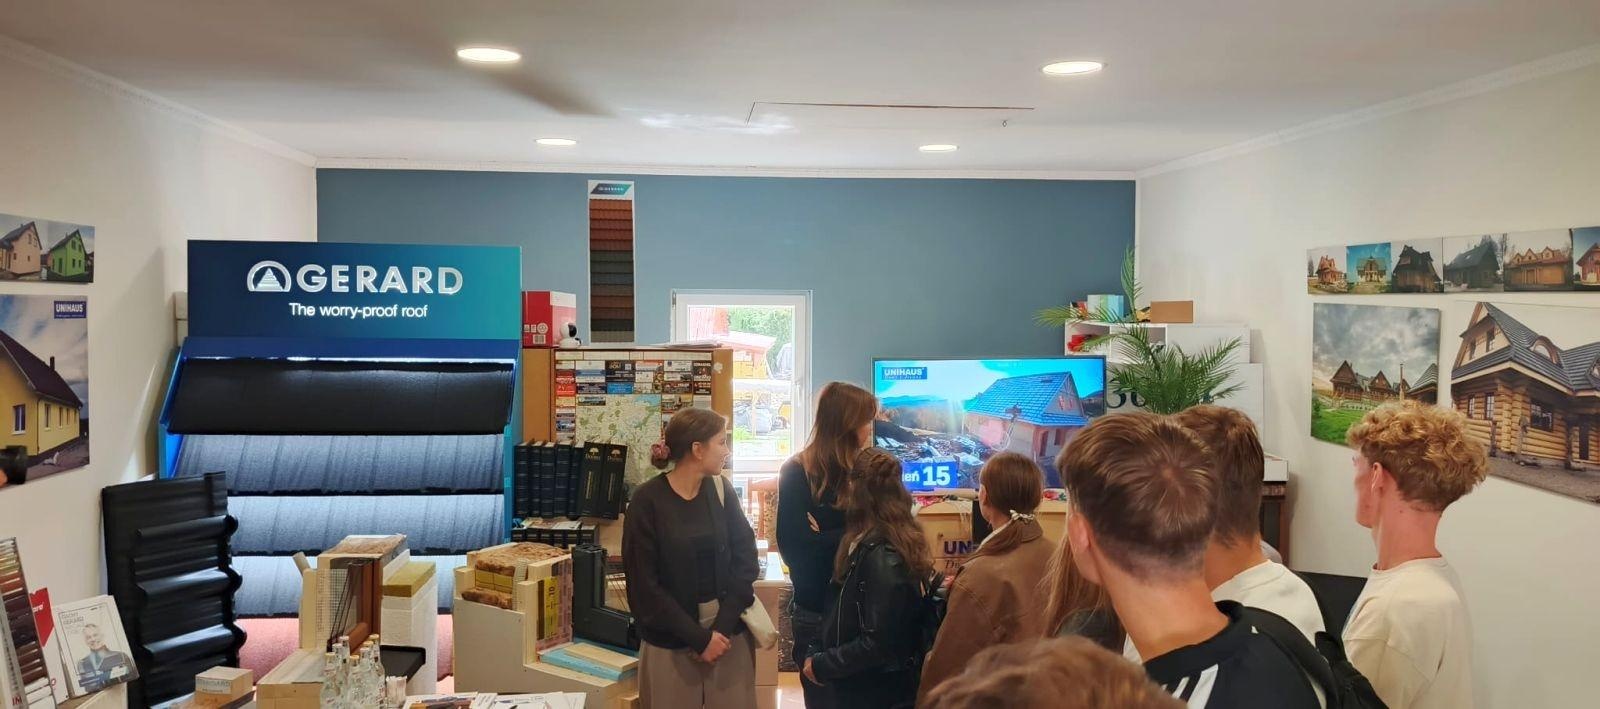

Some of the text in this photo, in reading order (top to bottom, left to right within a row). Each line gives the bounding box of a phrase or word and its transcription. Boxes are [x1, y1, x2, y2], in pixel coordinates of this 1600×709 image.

[296, 263, 463, 295] GERARD
[288, 302, 429, 319] The worry-proof roof
[884, 368, 923, 376] UNIHAUS
[922, 465, 951, 486] 15
[944, 540, 972, 555] UN
